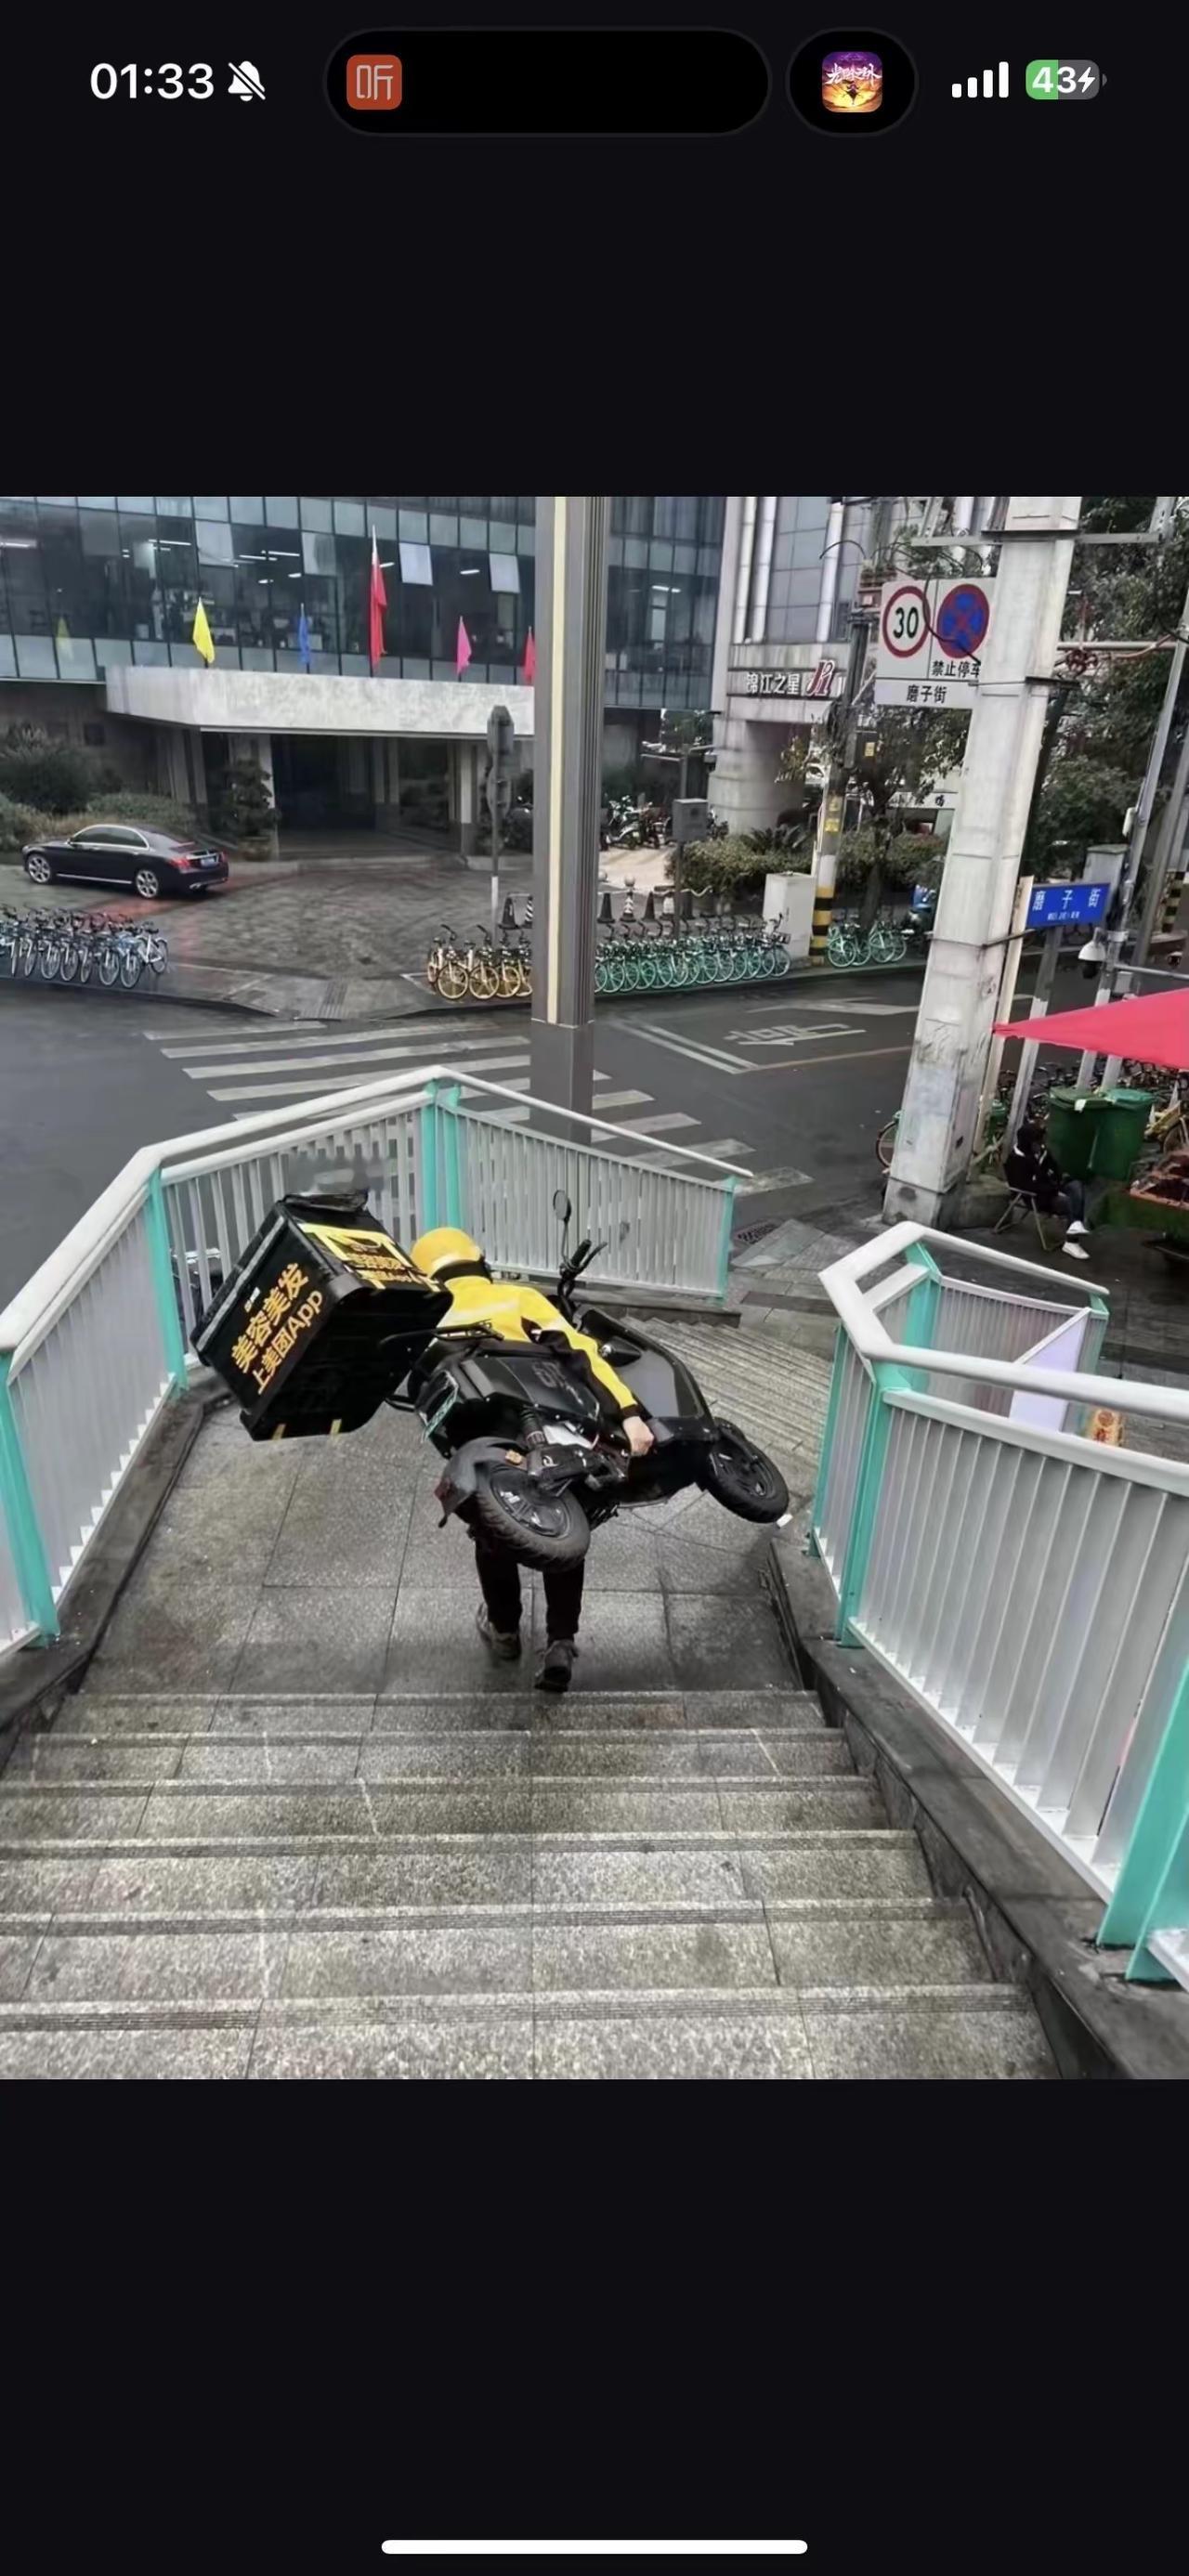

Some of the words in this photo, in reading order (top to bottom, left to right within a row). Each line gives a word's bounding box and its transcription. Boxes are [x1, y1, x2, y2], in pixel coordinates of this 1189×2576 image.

[893, 606, 920, 639] 30
[746, 671, 800, 695] 锦江之星
[932, 660, 981, 678] 禁止停车
[907, 684, 947, 703] 磨子街
[231, 1263, 308, 1373] 美容美发
[252, 1291, 322, 1395] 上美团App
